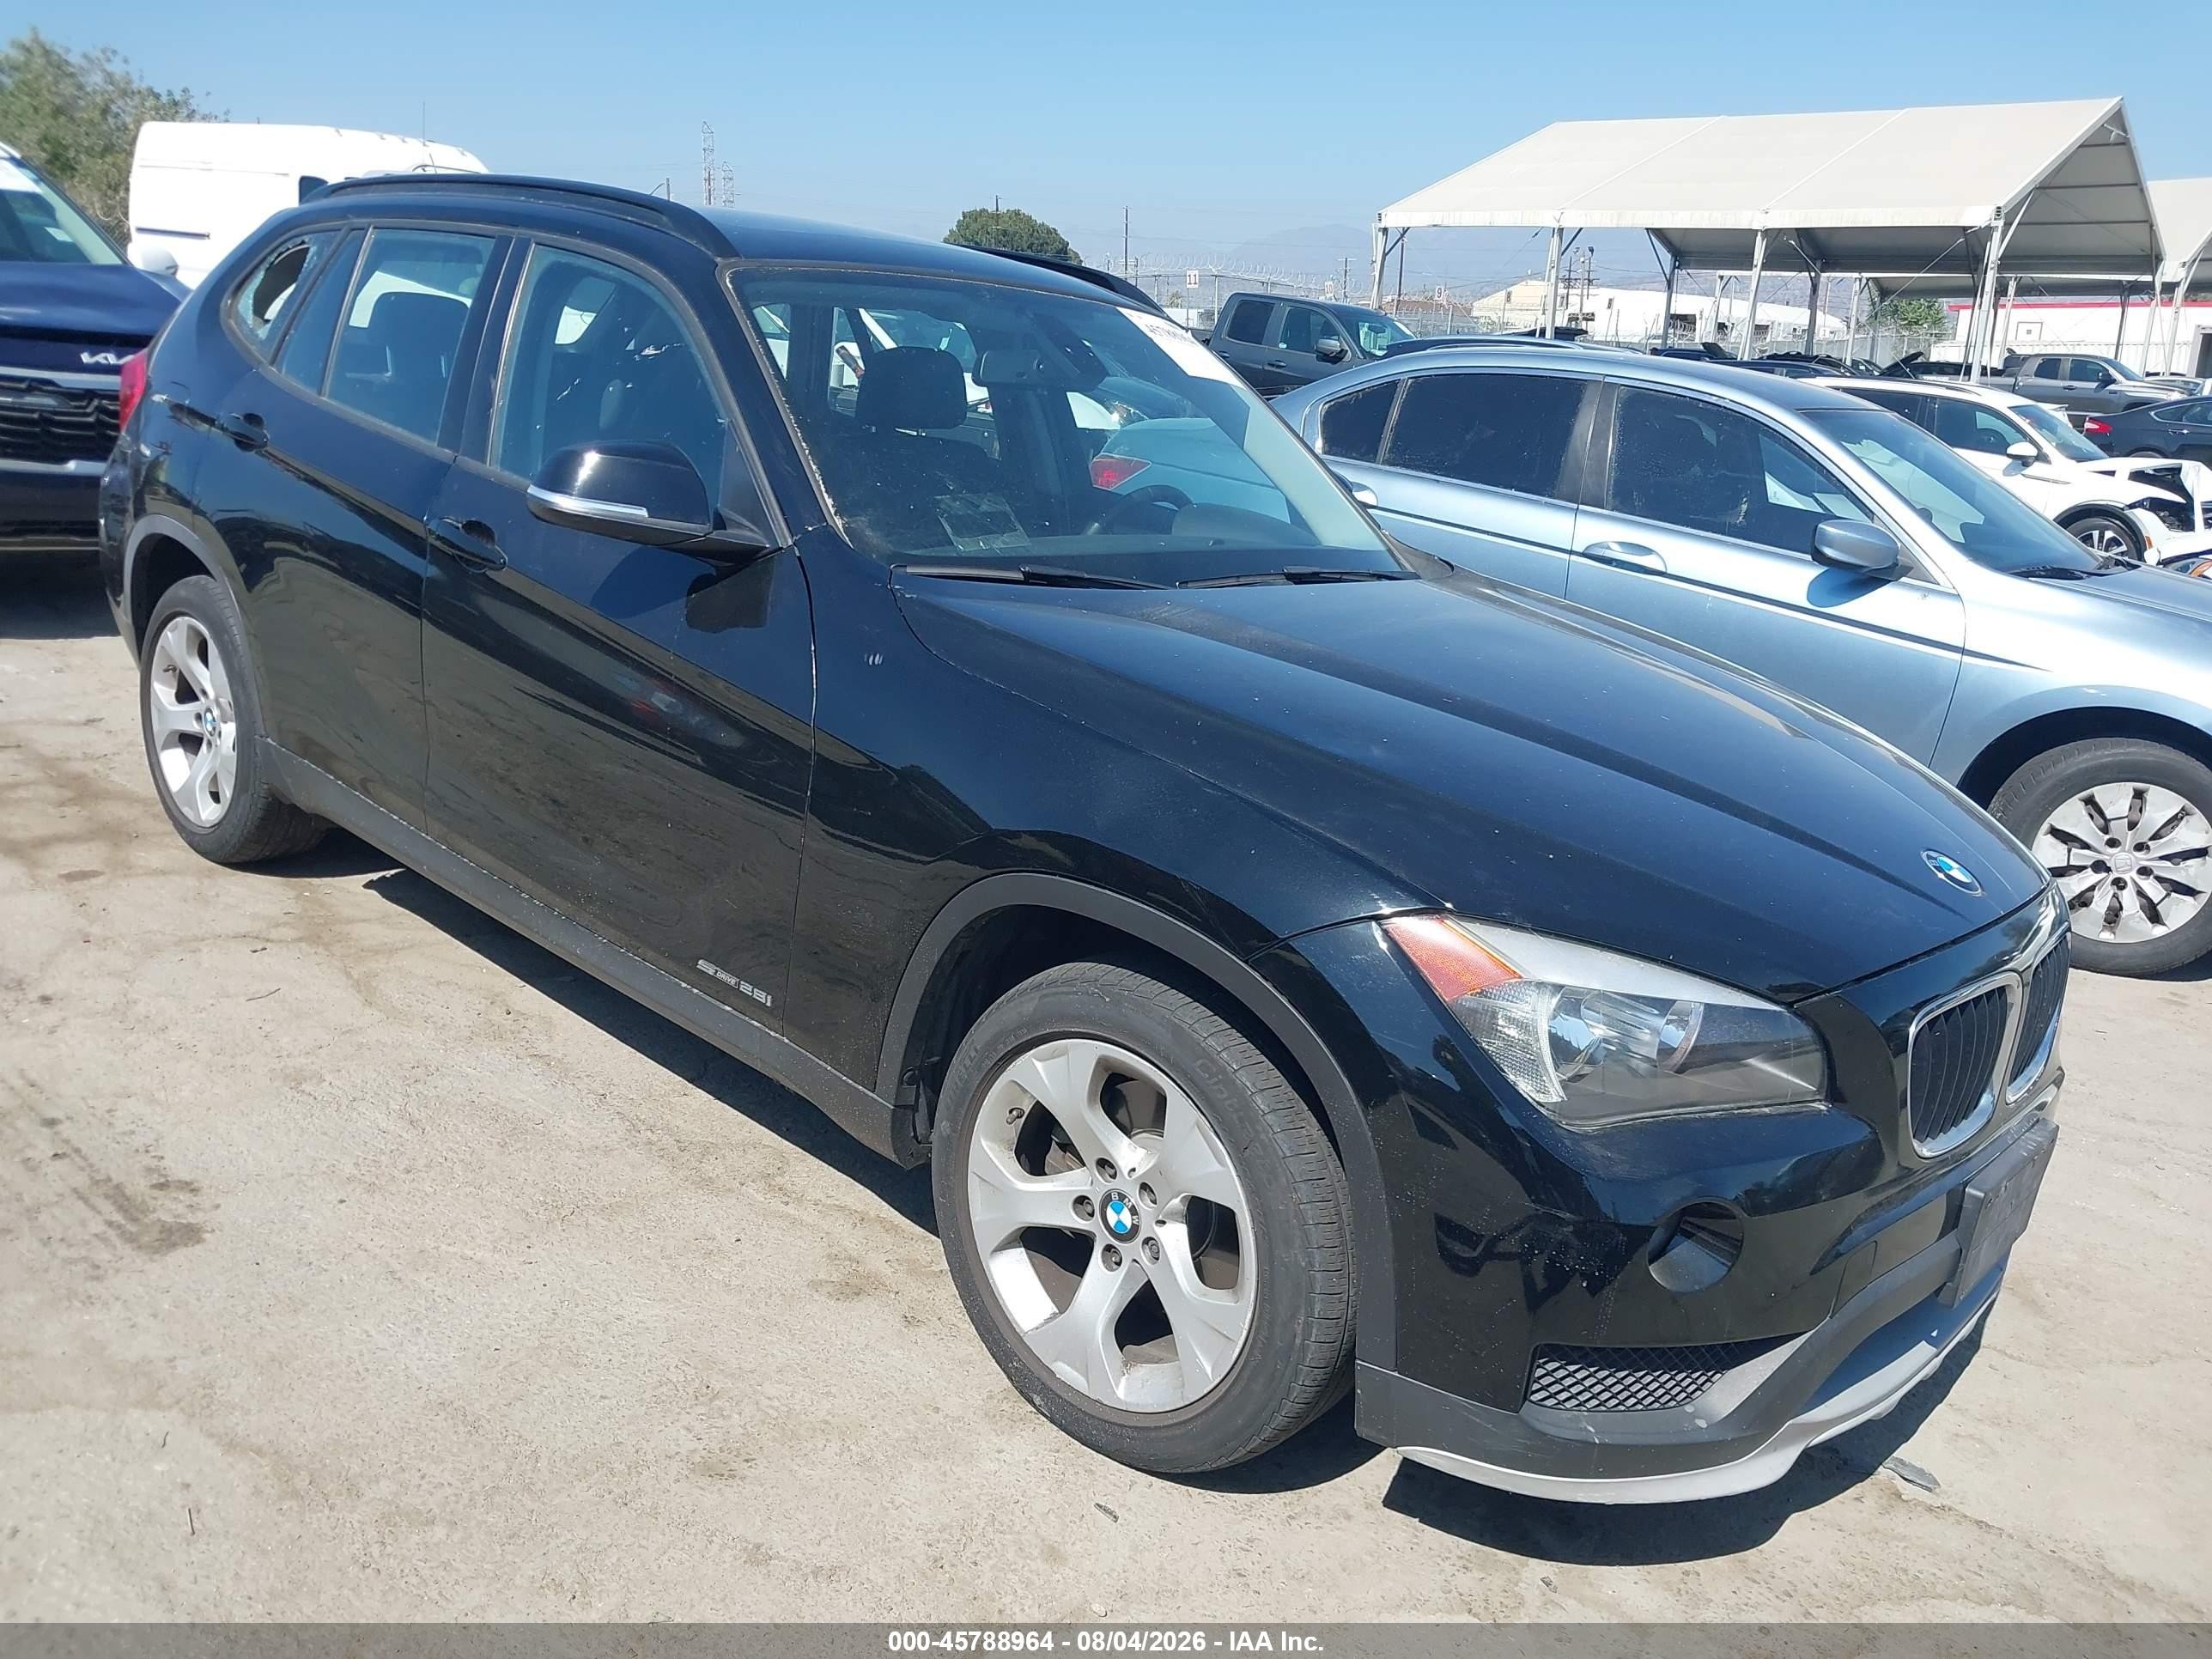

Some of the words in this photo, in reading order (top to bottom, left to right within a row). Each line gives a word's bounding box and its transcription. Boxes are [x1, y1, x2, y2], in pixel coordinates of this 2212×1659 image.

[1188, 274, 1198, 285] 11
[1437, 287, 1443, 299] 9
[1111, 1191, 1140, 1226] BMW
